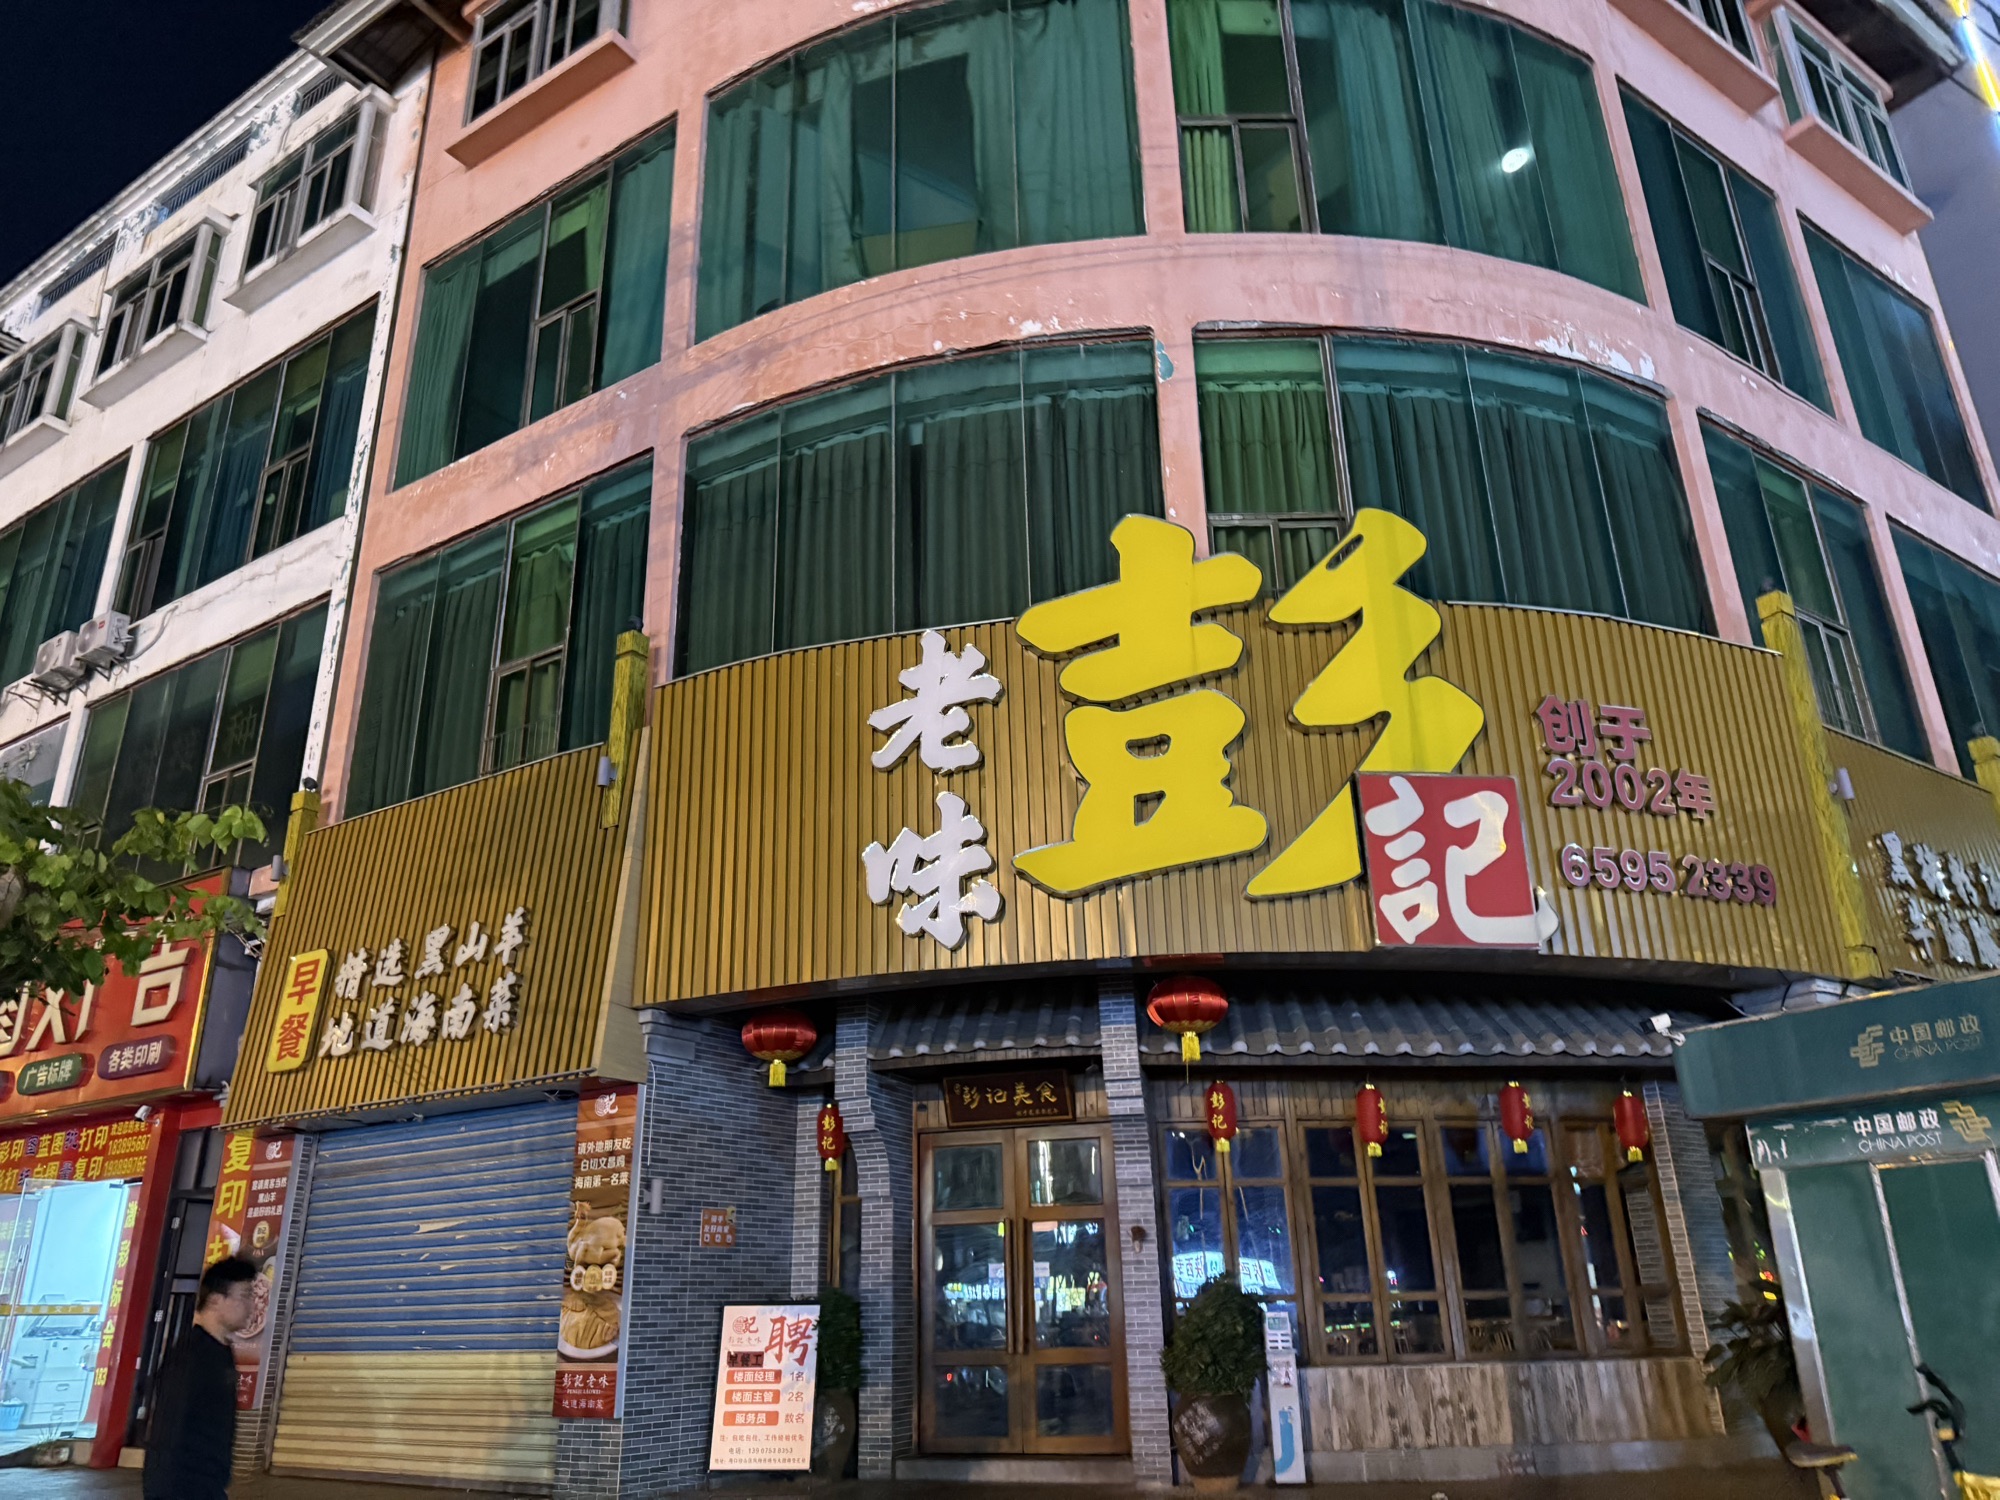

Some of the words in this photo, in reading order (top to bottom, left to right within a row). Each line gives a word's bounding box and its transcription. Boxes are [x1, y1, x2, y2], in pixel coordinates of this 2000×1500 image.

[1534, 694, 1652, 760] 创于
[863, 628, 1004, 950] 老味
[1546, 757, 1716, 821] 2002年
[1561, 842, 1677, 894] 6595
[1680, 854, 1778, 908] 2339
[334, 906, 526, 1001] 精选黑山羊
[274, 957, 321, 1062] 早餐
[318, 970, 518, 1057] 地道海南菜
[1889, 1013, 1981, 1046] 中国邮政
[22, 1058, 74, 1090] 广告标牌
[107, 1040, 163, 1074] 各类印刷
[962, 1081, 1058, 1110] 彭记美食
[1209, 1090, 1228, 1130] 彭记
[78, 1125, 109, 1152] 打印
[821, 1113, 836, 1150] 彭记
[1852, 1107, 1941, 1137] 中国邮政
[1858, 1136, 1906, 1154] CHINA
[1905, 1131, 1942, 1148] POST
[73, 1155, 104, 1181] 复印
[764, 1313, 812, 1366] 聘
[733, 1371, 775, 1382] 楼面经理
[790, 1371, 804, 1382] 1名
[732, 1391, 774, 1403] 楼面主管
[788, 1391, 805, 1402] 2名
[735, 1413, 767, 1424] 服务员
[785, 1412, 805, 1424] 数名
